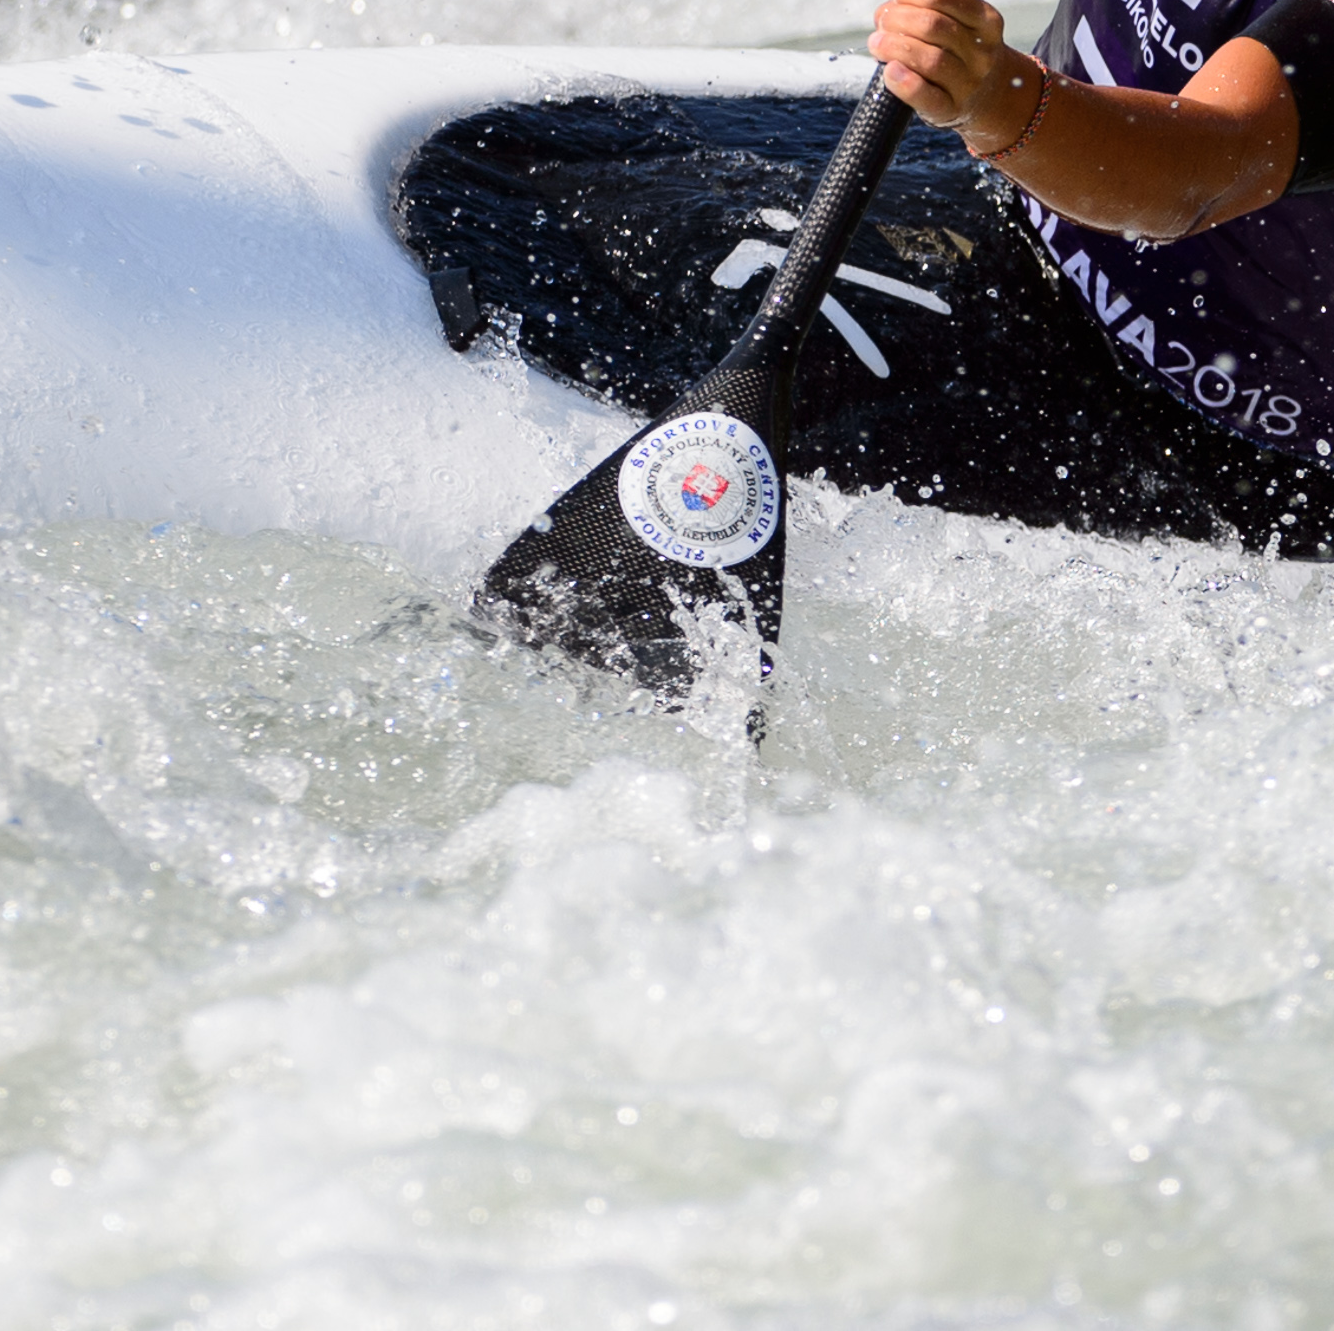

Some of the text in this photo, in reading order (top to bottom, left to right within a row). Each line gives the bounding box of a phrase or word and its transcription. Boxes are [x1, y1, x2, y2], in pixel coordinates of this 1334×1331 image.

[630, 419, 774, 544] ŠPORTOVÉ CENTRUM
[743, 469, 758, 508] ZBOR
